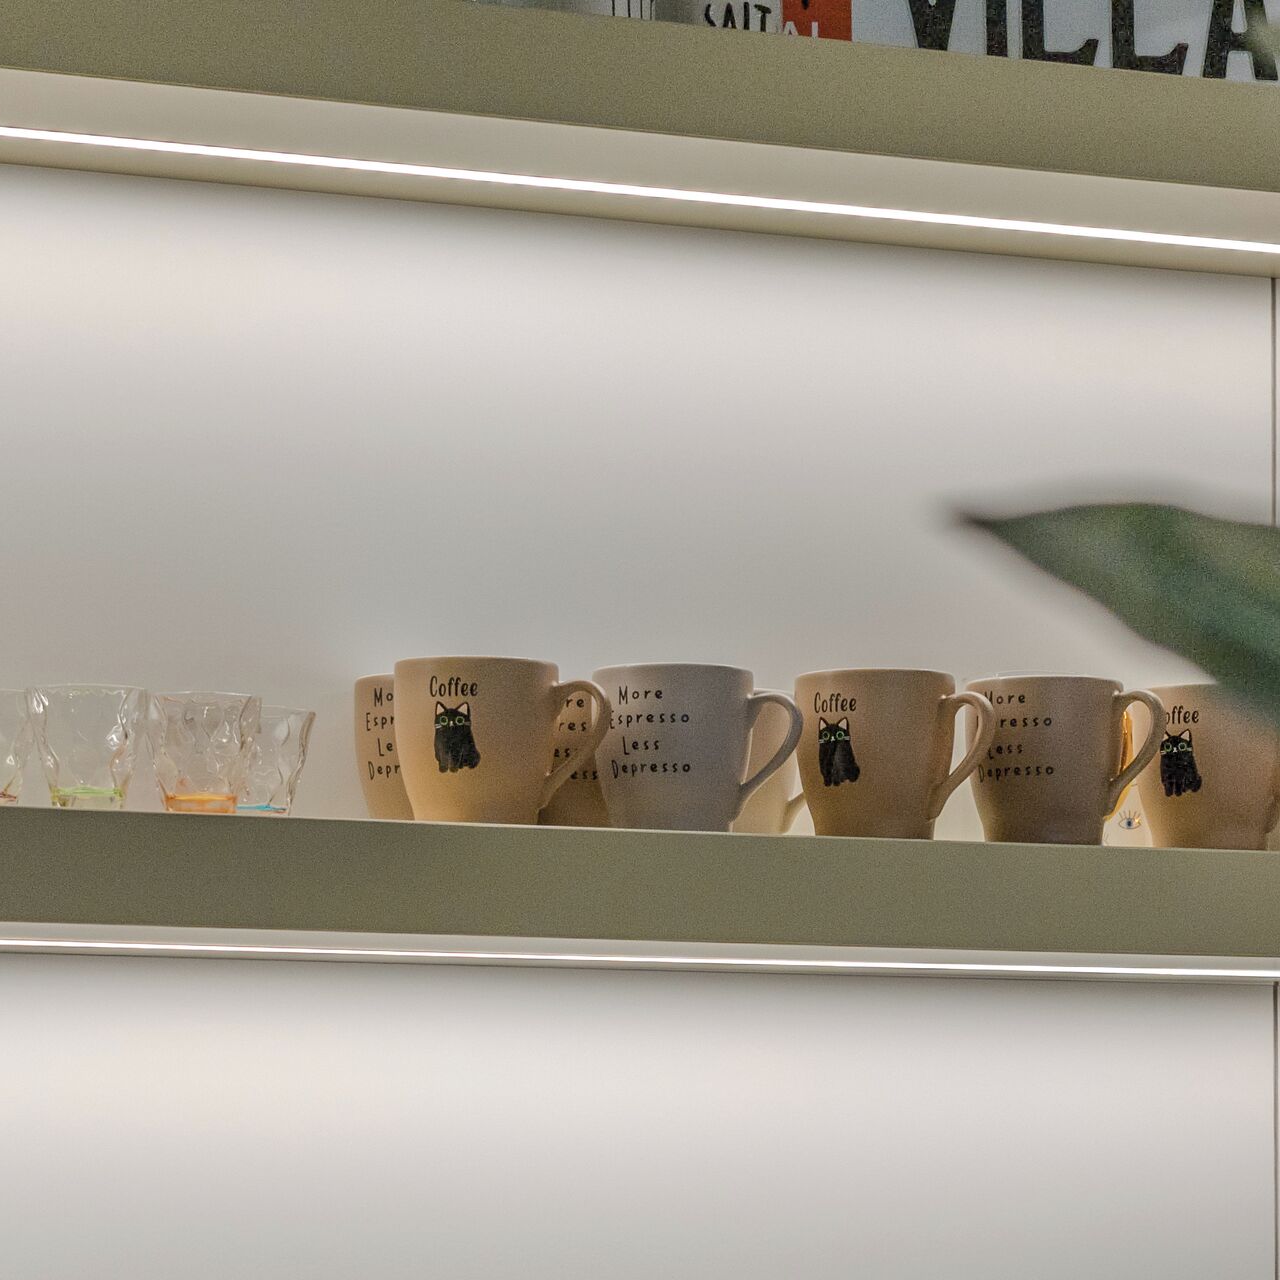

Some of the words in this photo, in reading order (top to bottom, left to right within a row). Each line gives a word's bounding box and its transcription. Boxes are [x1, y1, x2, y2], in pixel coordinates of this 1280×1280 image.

[429, 675, 478, 697] Coffee
[618, 685, 663, 705] More
[814, 691, 857, 713] Coffee
[609, 710, 690, 730] Espresso
[622, 736, 660, 755] Less
[611, 759, 691, 779] Depresso
[978, 763, 1054, 783] Depresso
